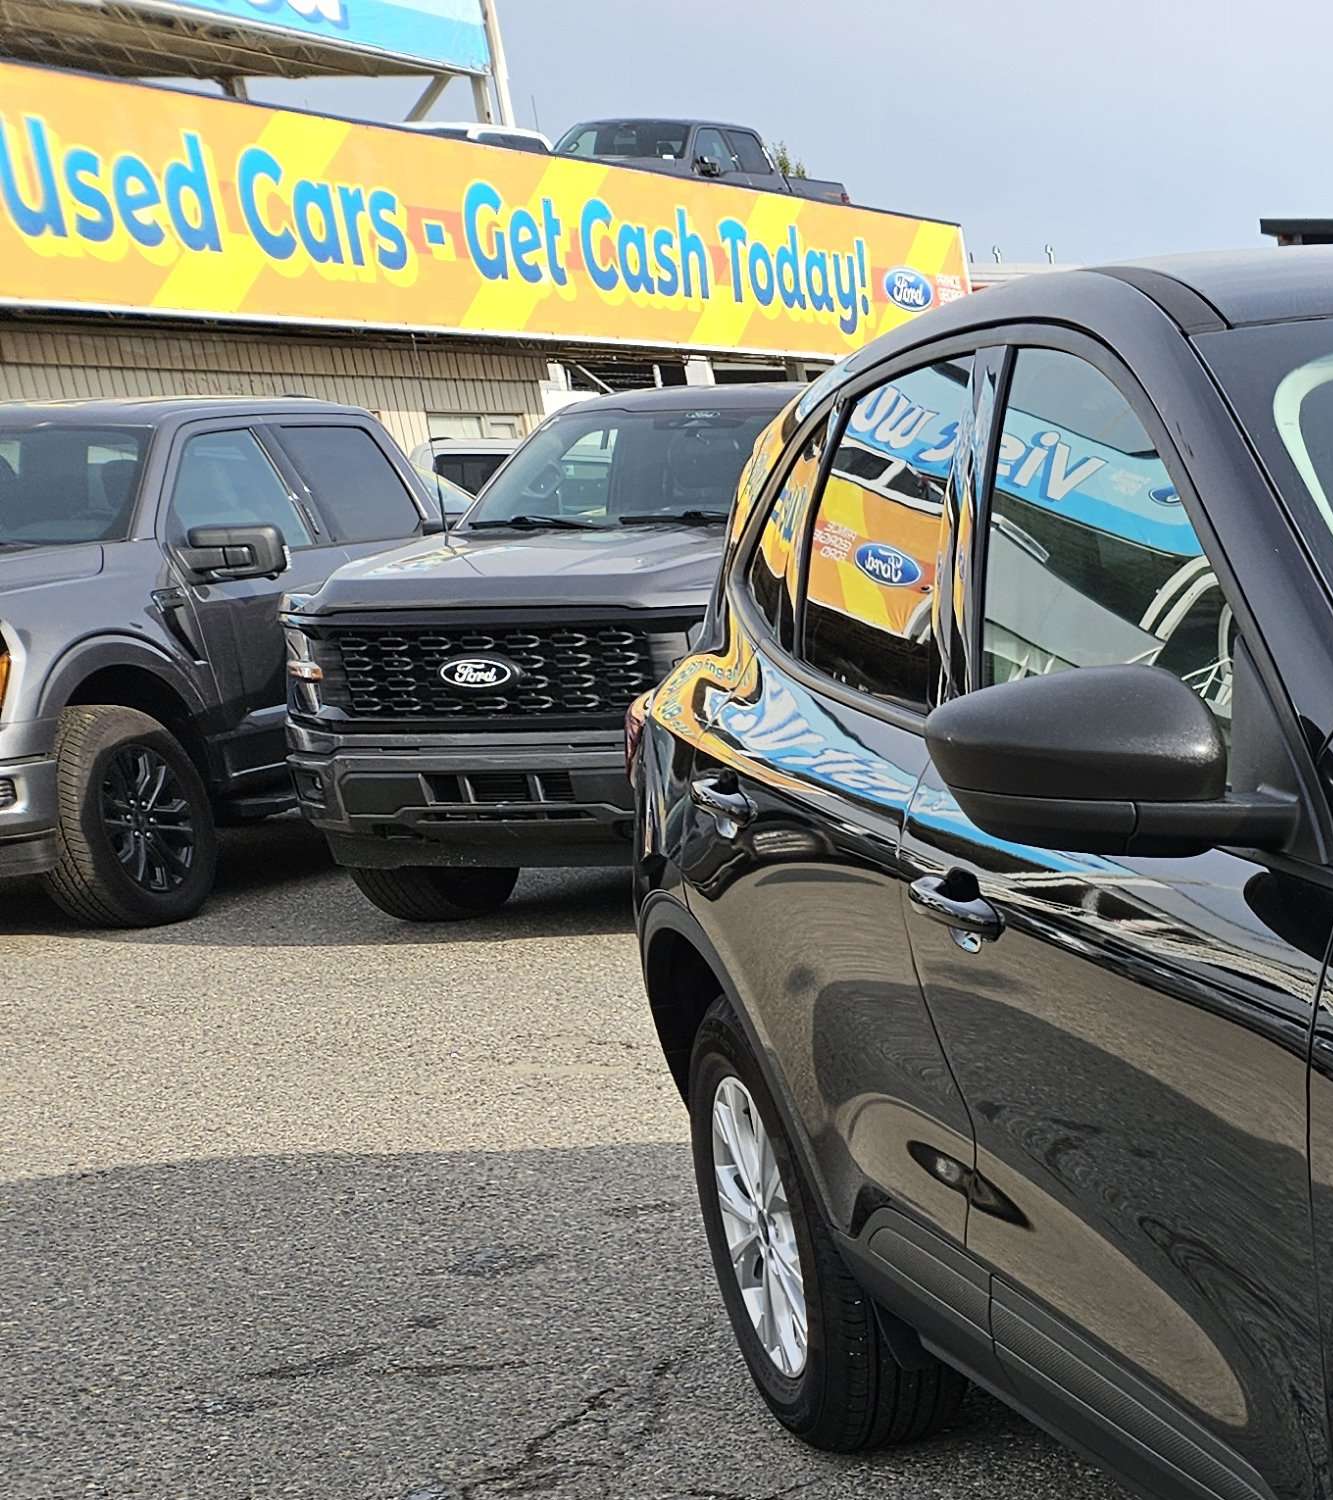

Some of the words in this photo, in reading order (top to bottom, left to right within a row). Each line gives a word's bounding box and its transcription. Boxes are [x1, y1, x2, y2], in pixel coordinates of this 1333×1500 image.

[0, 116, 223, 252] Used
[237, 148, 408, 270] Cars
[464, 181, 567, 287] Get
[580, 198, 710, 300] Cash
[717, 218, 870, 335] Today!
